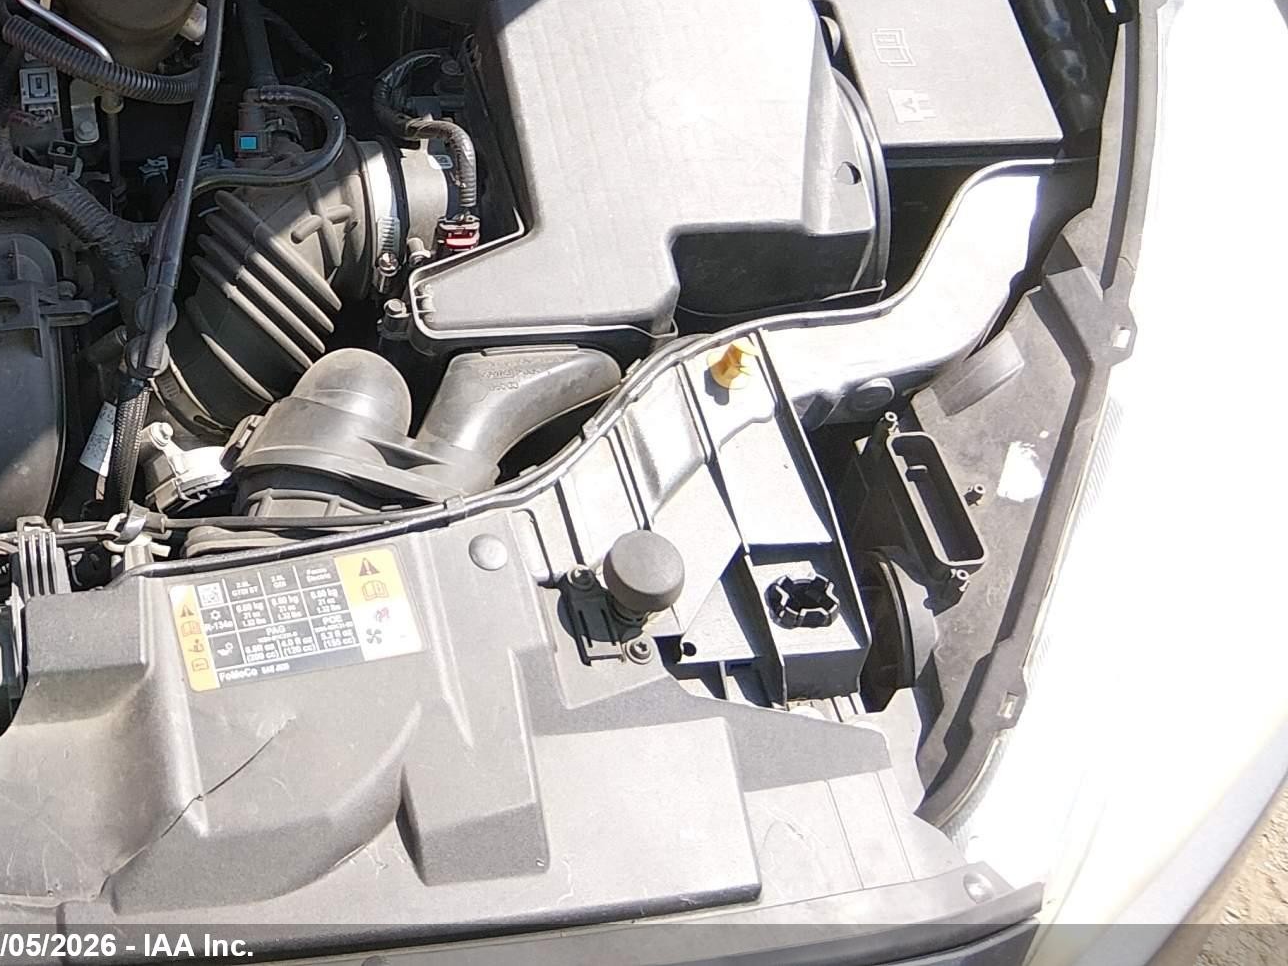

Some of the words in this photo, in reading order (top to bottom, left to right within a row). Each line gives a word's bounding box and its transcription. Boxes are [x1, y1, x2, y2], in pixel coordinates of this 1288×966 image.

[306, 573, 332, 582] Electric
[327, 588, 338, 597] kg
[288, 595, 299, 604] kg
[253, 602, 264, 611] kg
[322, 614, 343, 625] POE
[266, 625, 286, 636] PAG
[342, 634, 356, 645] cc)
[303, 642, 316, 652] cc)
[265, 650, 280, 659] cc)
[219, 667, 258, 682] FoMoCo
